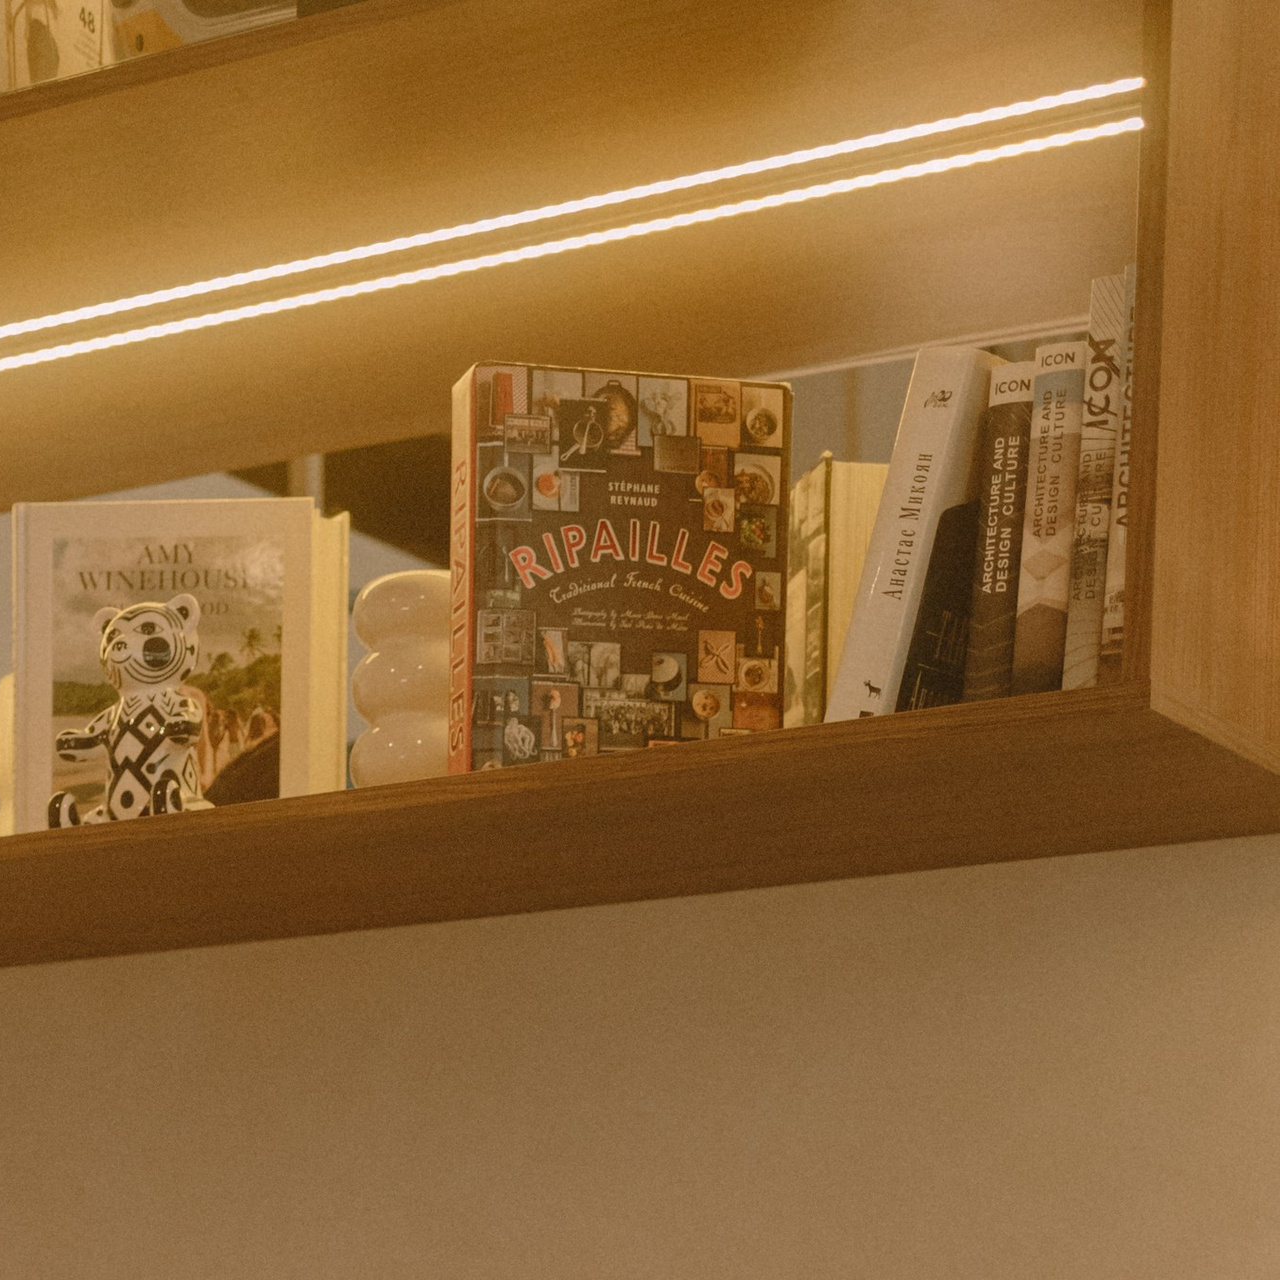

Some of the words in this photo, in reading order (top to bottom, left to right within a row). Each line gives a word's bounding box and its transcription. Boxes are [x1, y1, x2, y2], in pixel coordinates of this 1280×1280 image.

[994, 378, 1032, 396] ICON
[1041, 351, 1076, 367] ICON
[1041, 390, 1053, 421] AND
[1051, 388, 1067, 464] CULTURE
[608, 480, 661, 495] STÉPHANE
[610, 495, 659, 508] REYNAUD
[898, 453, 933, 521] Микоян
[1002, 436, 1021, 516] CULTURE
[1032, 424, 1051, 538] ARCHITECTURE
[1045, 474, 1061, 537] DESIGN
[981, 474, 1003, 593] ARCHITECTURE
[992, 436, 1005, 472] AND
[137, 543, 194, 565] AMY
[508, 518, 753, 600] RIPAILLES
[881, 529, 916, 601] Анастас
[996, 527, 1013, 592] DESIGN
[450, 459, 467, 757] RIPAILLES
[548, 572, 618, 604] Traditional
[623, 571, 664, 591] French
[668, 583, 710, 613] Cuisine
